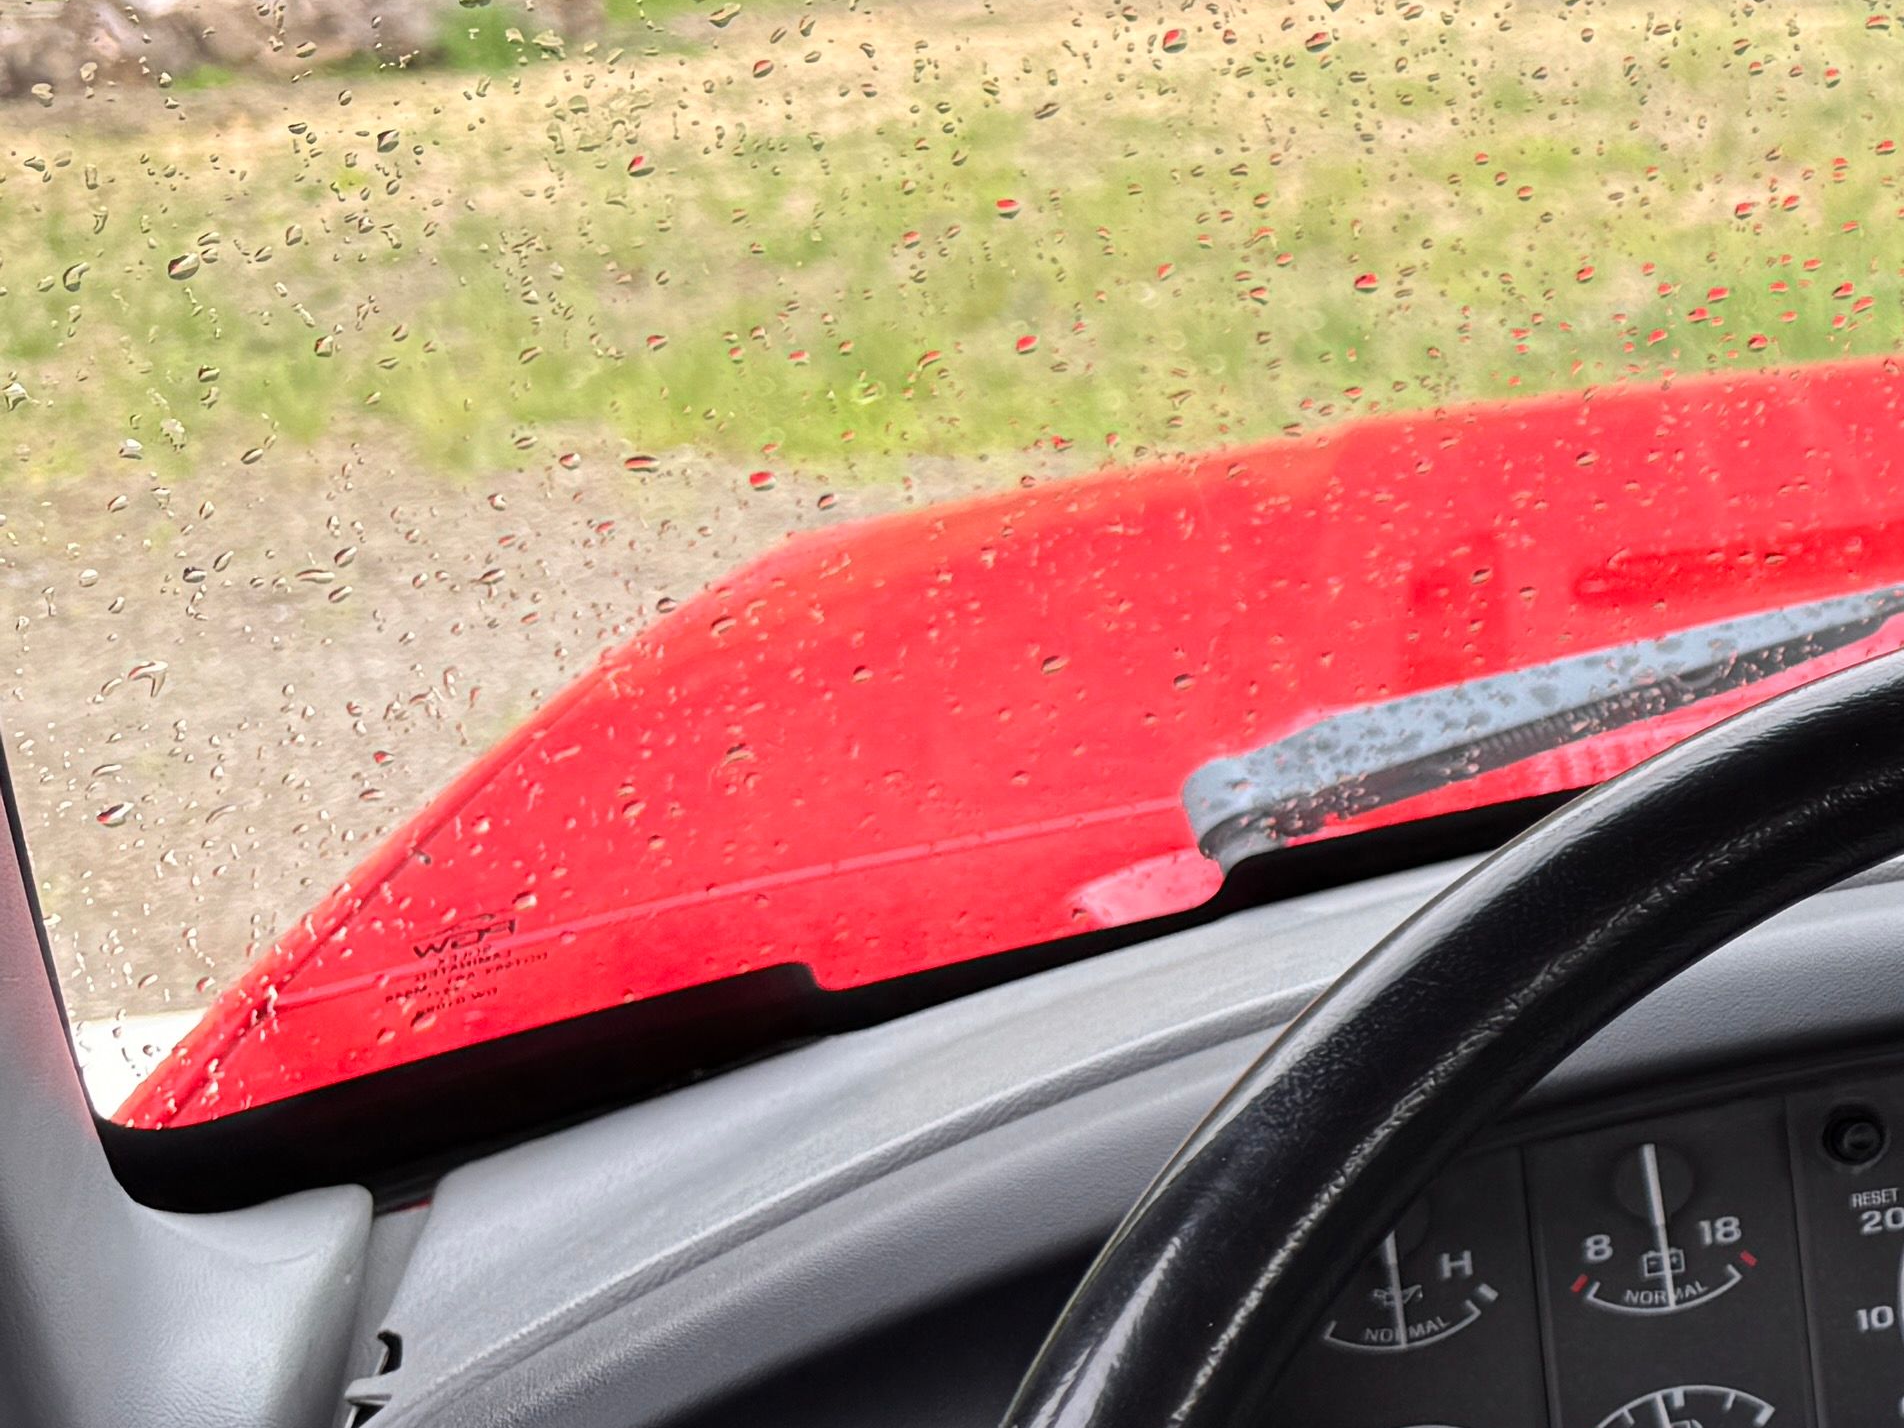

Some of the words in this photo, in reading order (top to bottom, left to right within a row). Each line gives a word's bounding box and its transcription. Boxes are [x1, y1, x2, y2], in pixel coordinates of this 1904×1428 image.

[1851, 1188, 1899, 1209] RESET
[1699, 1216, 1742, 1245] 18
[1585, 1234, 1614, 1263] 8
[1440, 1250, 1473, 1279] H
[1364, 1316, 1450, 1343] NOMAL
[1857, 1306, 1894, 1331] 10
